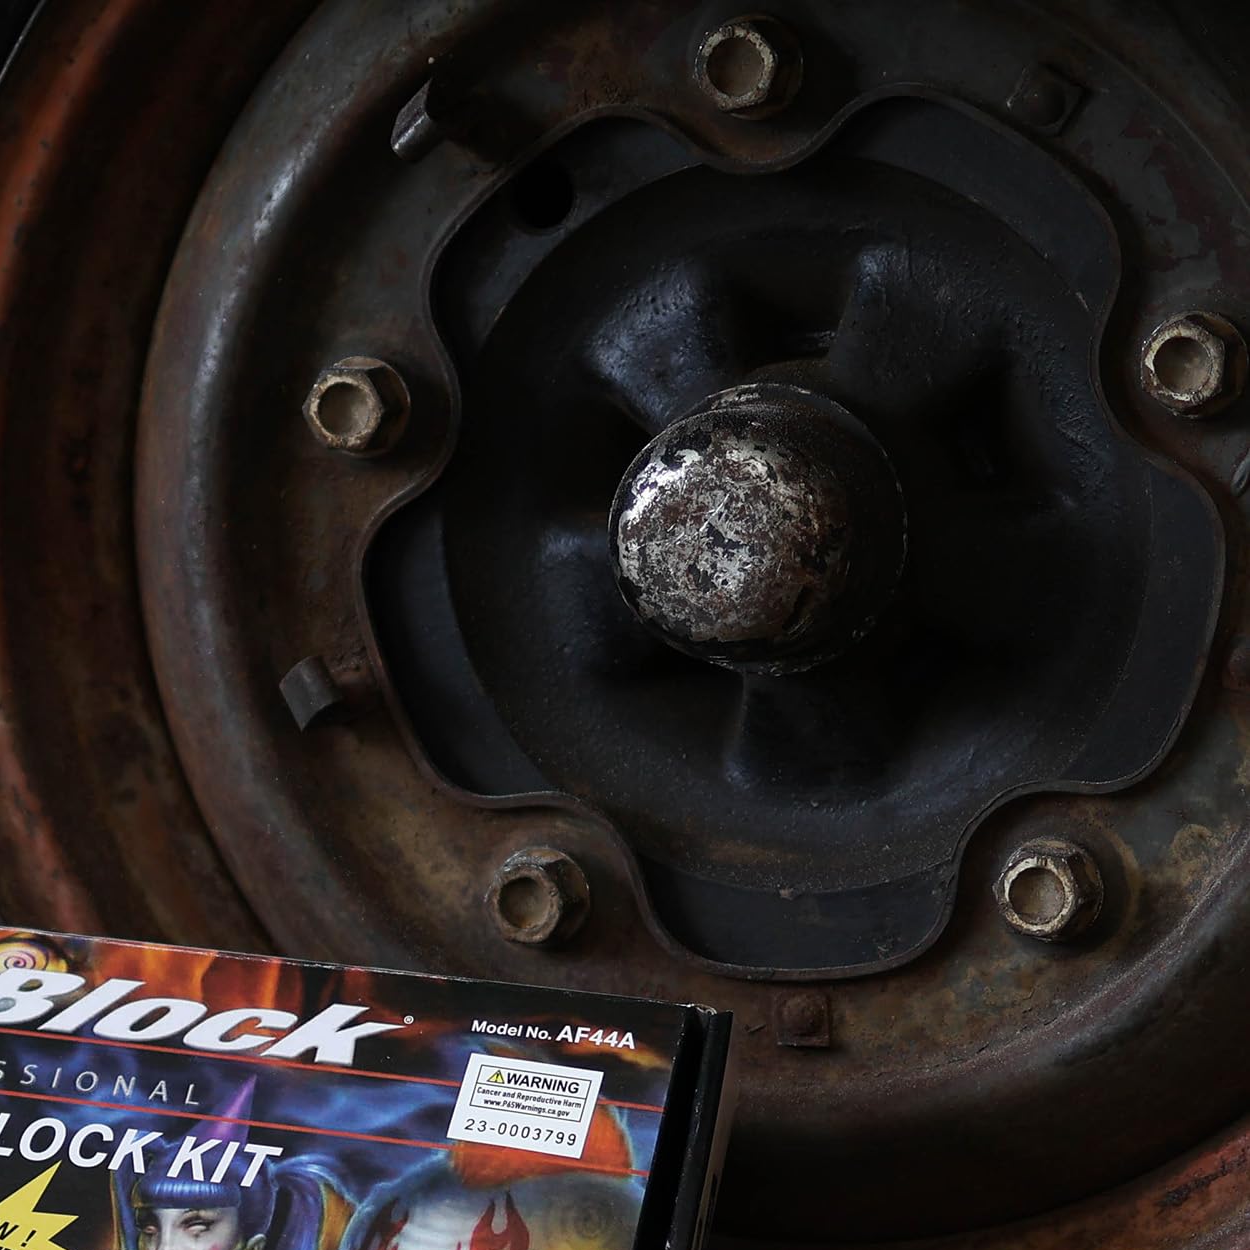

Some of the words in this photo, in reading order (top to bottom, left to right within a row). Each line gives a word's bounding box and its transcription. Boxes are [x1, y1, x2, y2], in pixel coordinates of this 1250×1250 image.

[471, 1019, 523, 1038] Model
[525, 1026, 552, 1040] No.
[555, 1025, 636, 1050] AF44A
[506, 1072, 580, 1095] WARNING
[477, 1086, 502, 1097] Cancer
[502, 1089, 516, 1099] and
[517, 1091, 562, 1106] Reproductive
[563, 1097, 582, 1109] Harm
[483, 1098, 570, 1117] www.P65Warnings.ca.gov
[464, 1118, 577, 1146] 23-0003799
[166, 1137, 284, 1188] KIT
